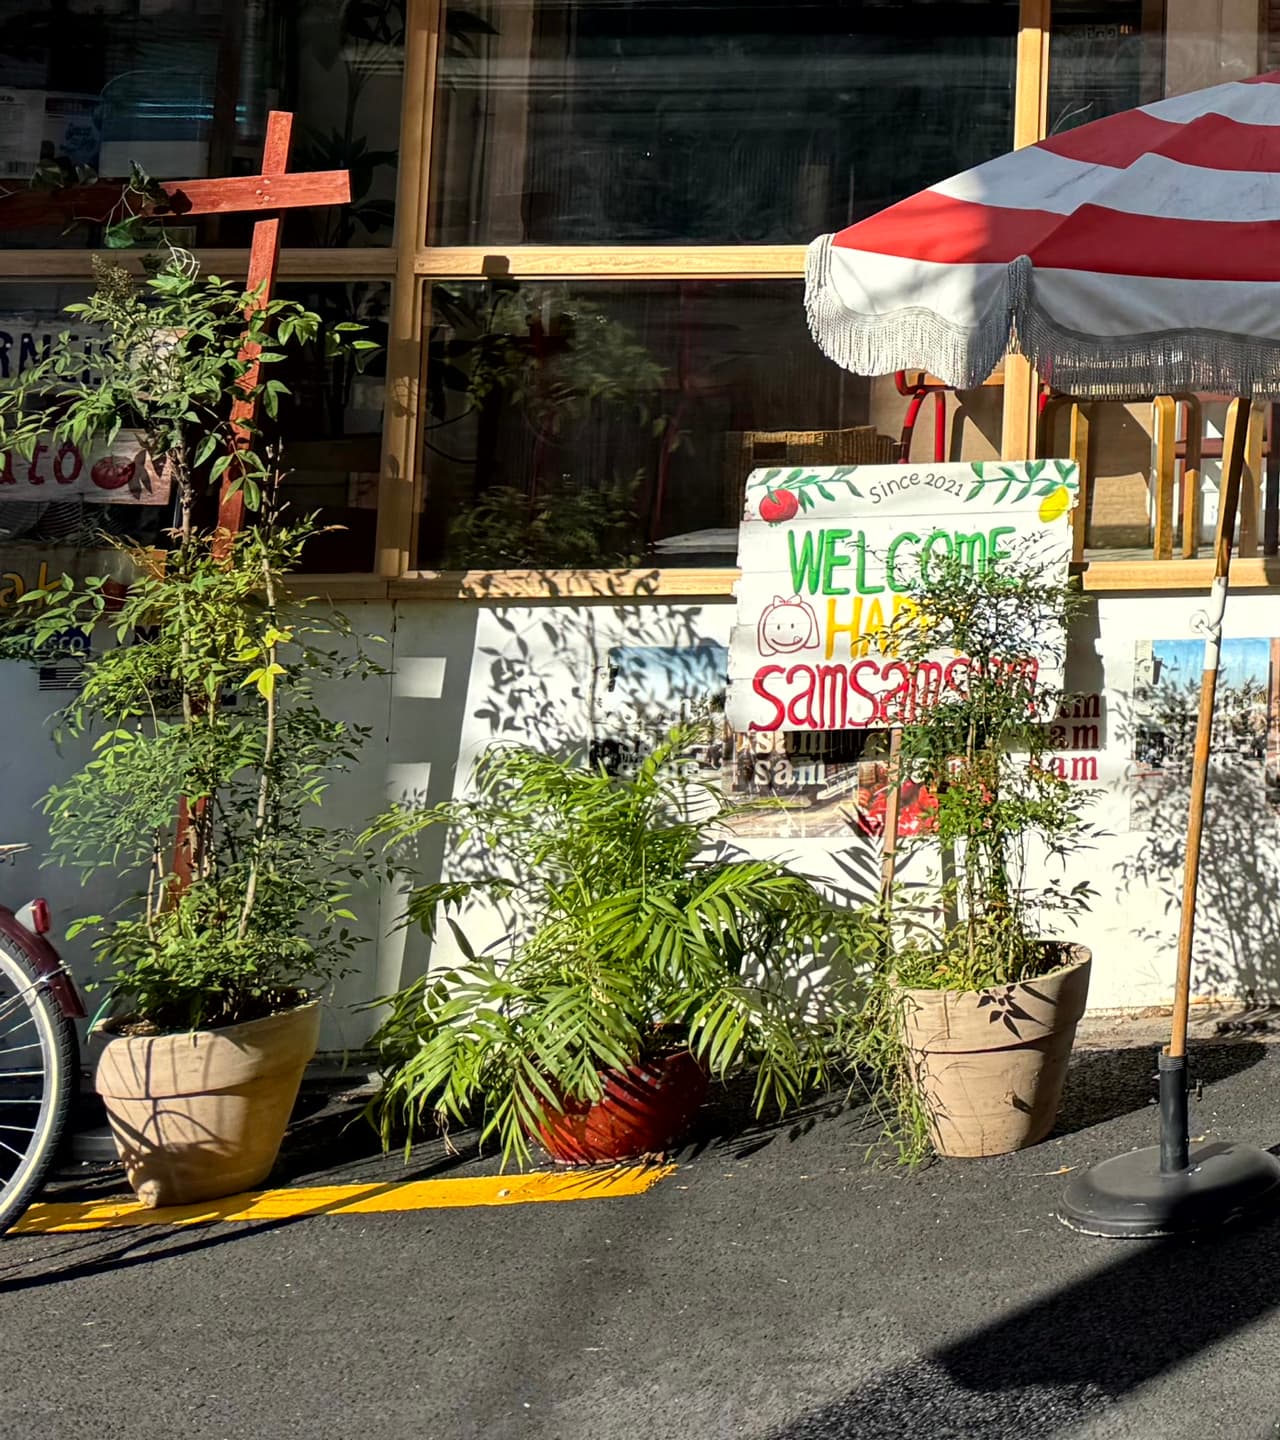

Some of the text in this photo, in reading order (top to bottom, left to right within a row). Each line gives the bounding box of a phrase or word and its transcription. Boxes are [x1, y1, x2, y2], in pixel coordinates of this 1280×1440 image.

[869, 472, 965, 504] Since 2021
[752, 758, 828, 786] sam
